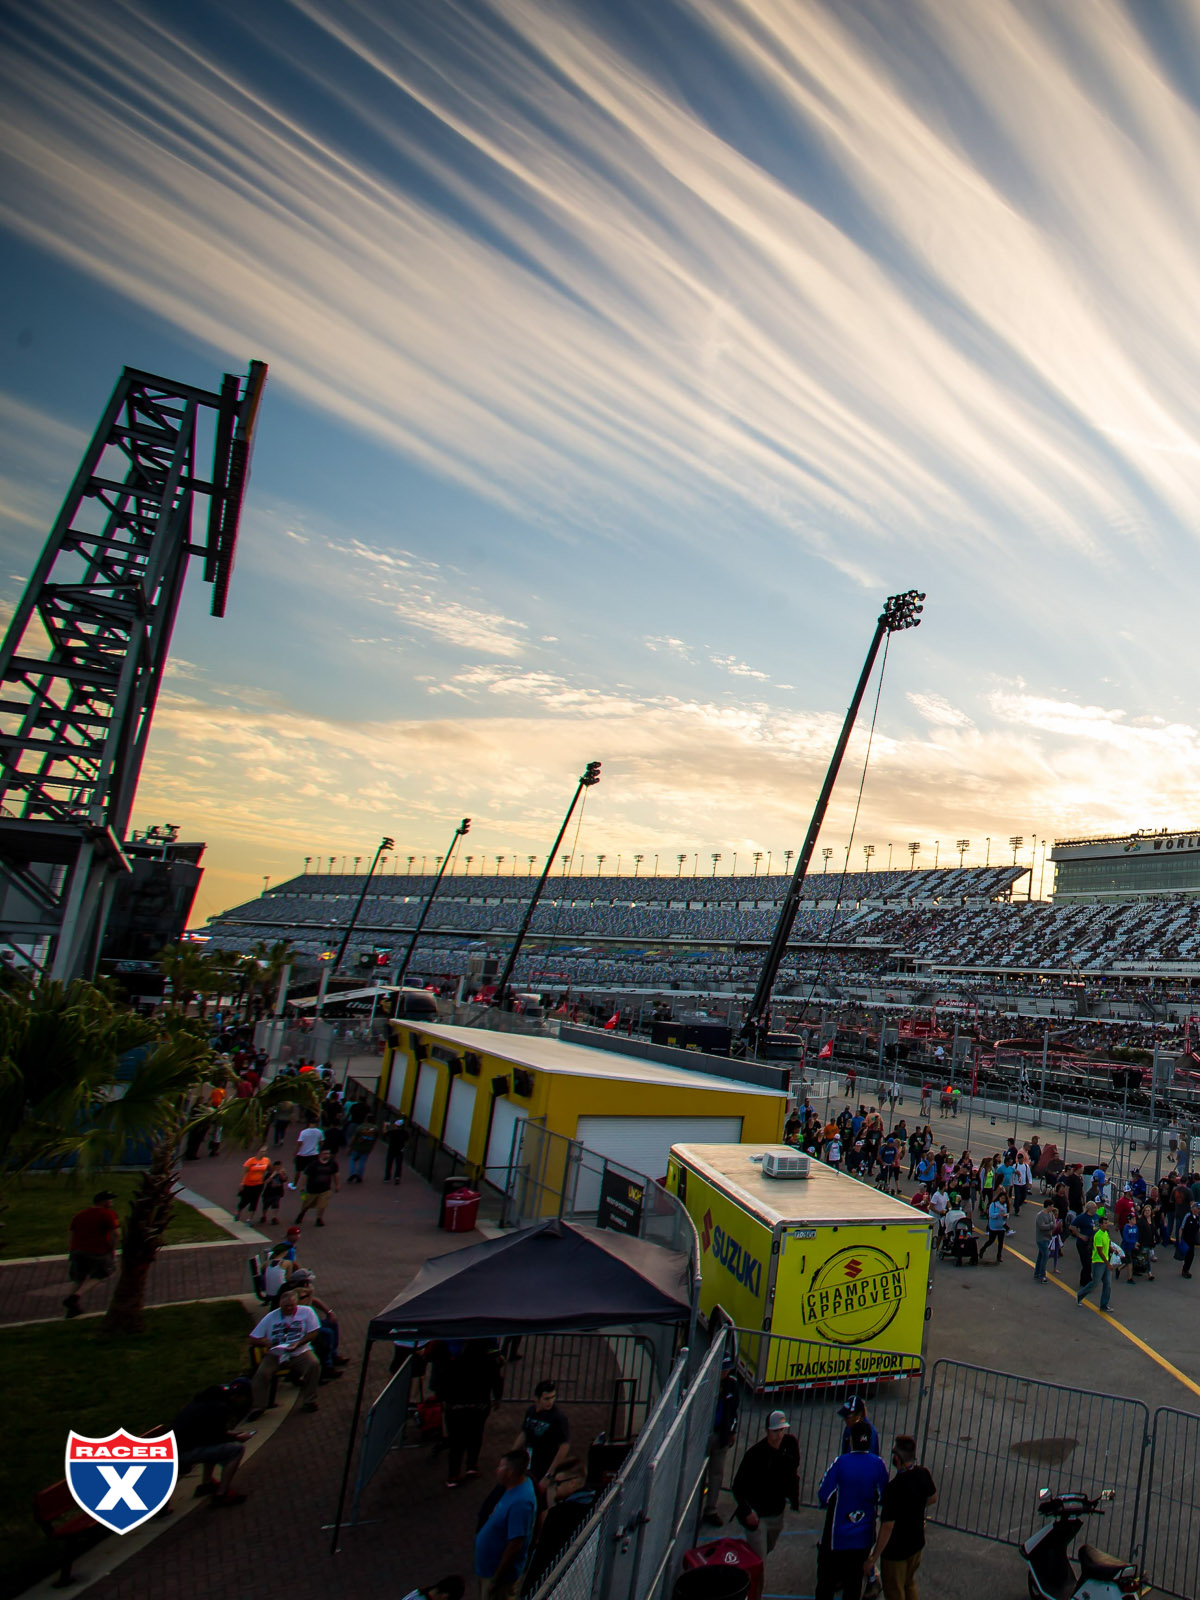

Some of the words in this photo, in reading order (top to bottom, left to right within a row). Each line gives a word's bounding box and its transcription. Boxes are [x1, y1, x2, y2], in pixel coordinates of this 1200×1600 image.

[712, 1224, 762, 1298] SUZUKI
[807, 1272, 901, 1308] CHAMPION
[807, 1285, 902, 1322] APPROVED
[789, 1359, 851, 1377] TRACKSIDE
[854, 1354, 904, 1372] SUPPORT
